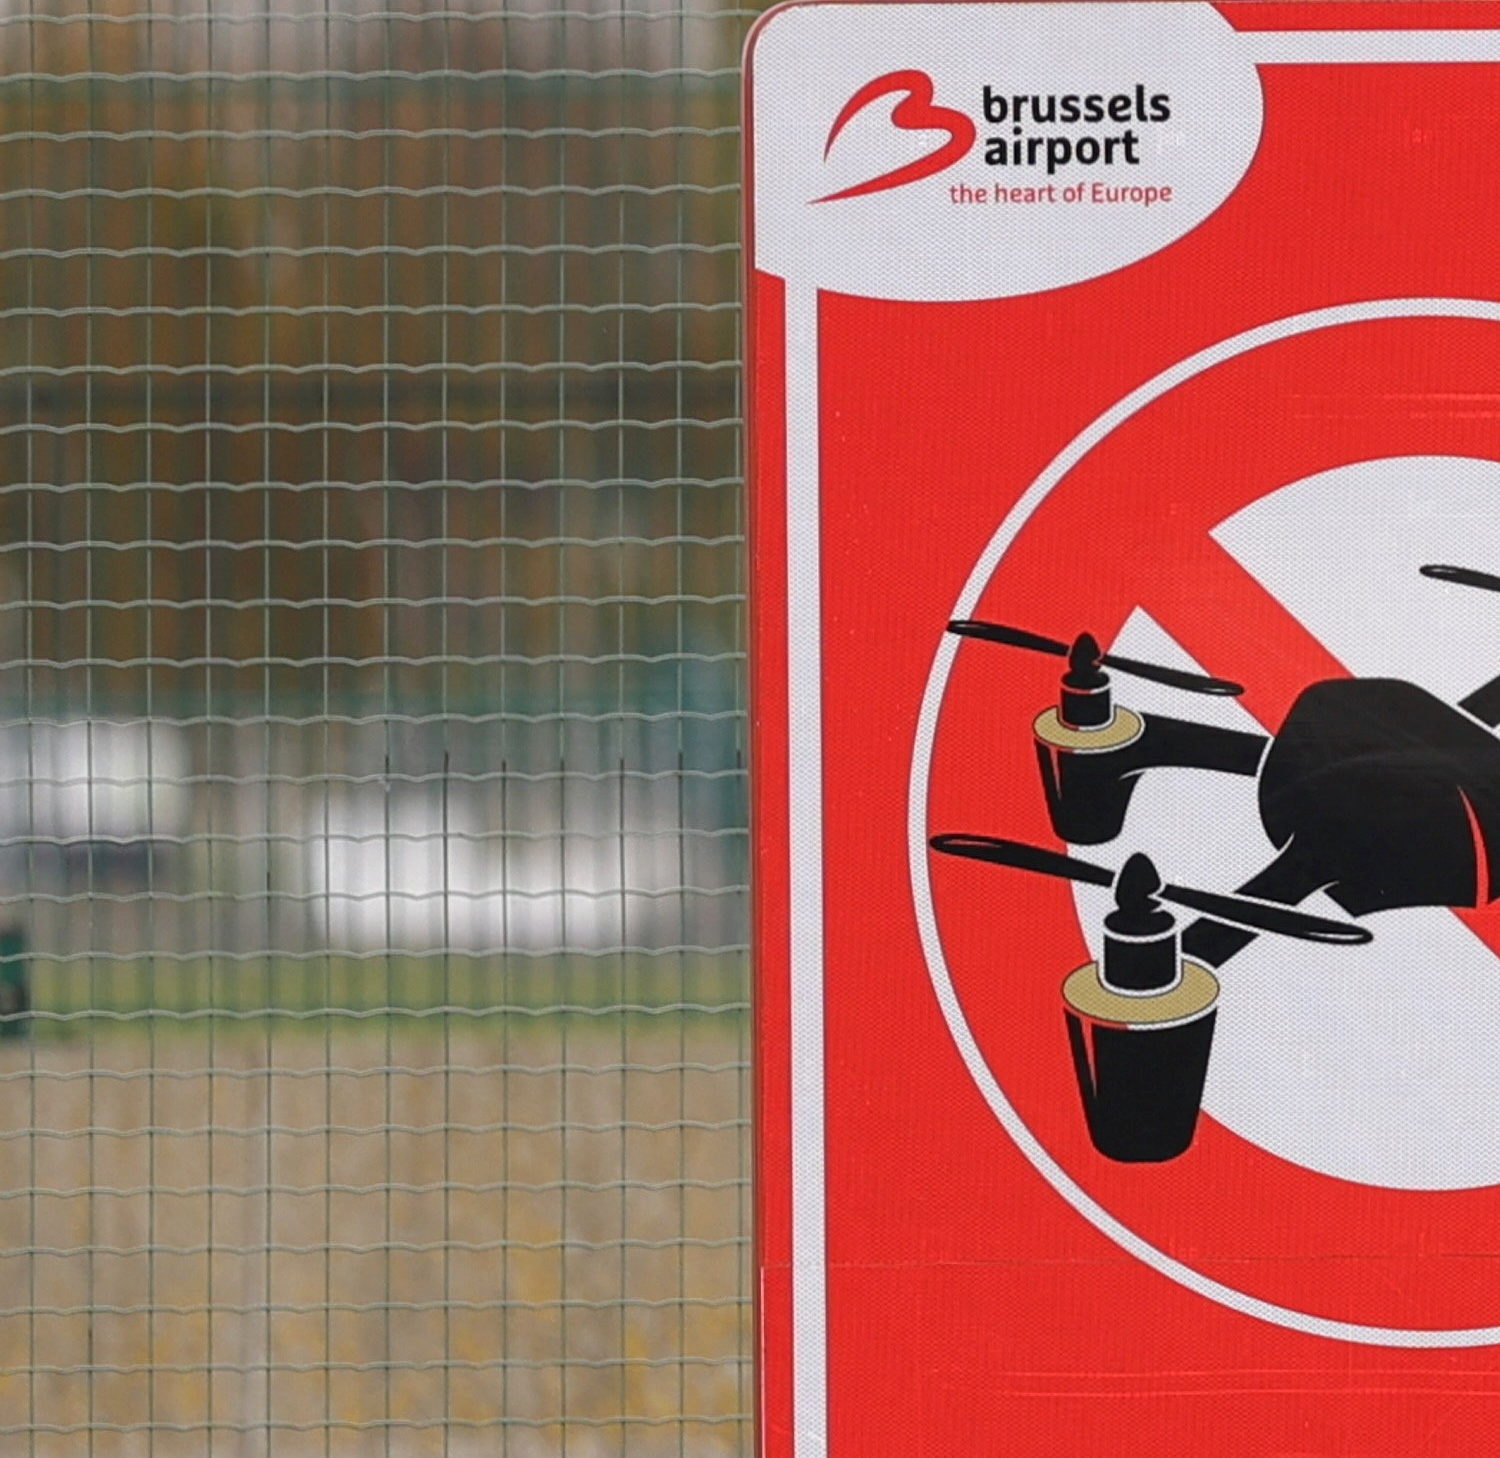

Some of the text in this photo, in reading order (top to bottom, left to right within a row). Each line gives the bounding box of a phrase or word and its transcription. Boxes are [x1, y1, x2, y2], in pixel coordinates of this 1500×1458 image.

[982, 84, 1172, 125] brussels
[984, 127, 1141, 175] airport
[950, 182, 1174, 207] the heart of Europe
